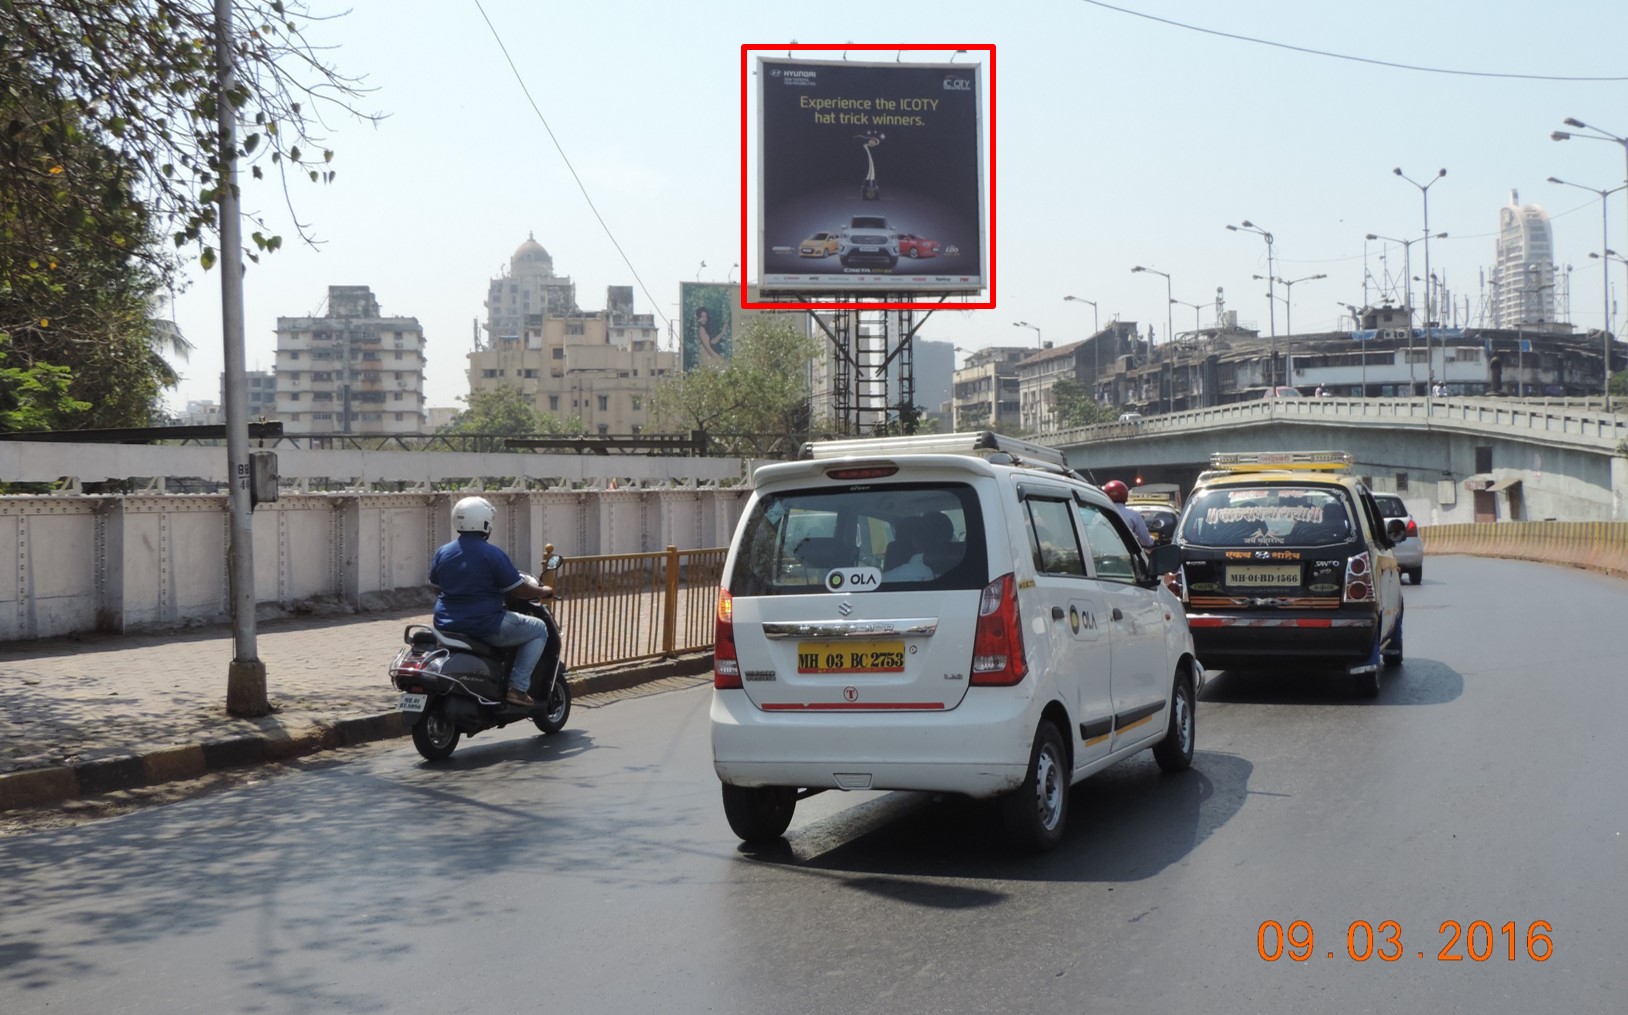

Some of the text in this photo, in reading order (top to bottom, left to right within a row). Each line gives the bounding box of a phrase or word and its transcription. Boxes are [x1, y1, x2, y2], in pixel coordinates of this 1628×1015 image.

[783, 70, 816, 78] HYUNDAI
[800, 96, 938, 111] Experience the ICOTY
[815, 112, 925, 126] hat trick winners.
[850, 573, 877, 585] OLA
[1082, 610, 1098, 630] OLA
[798, 651, 904, 668] MH 03 BC 2753
